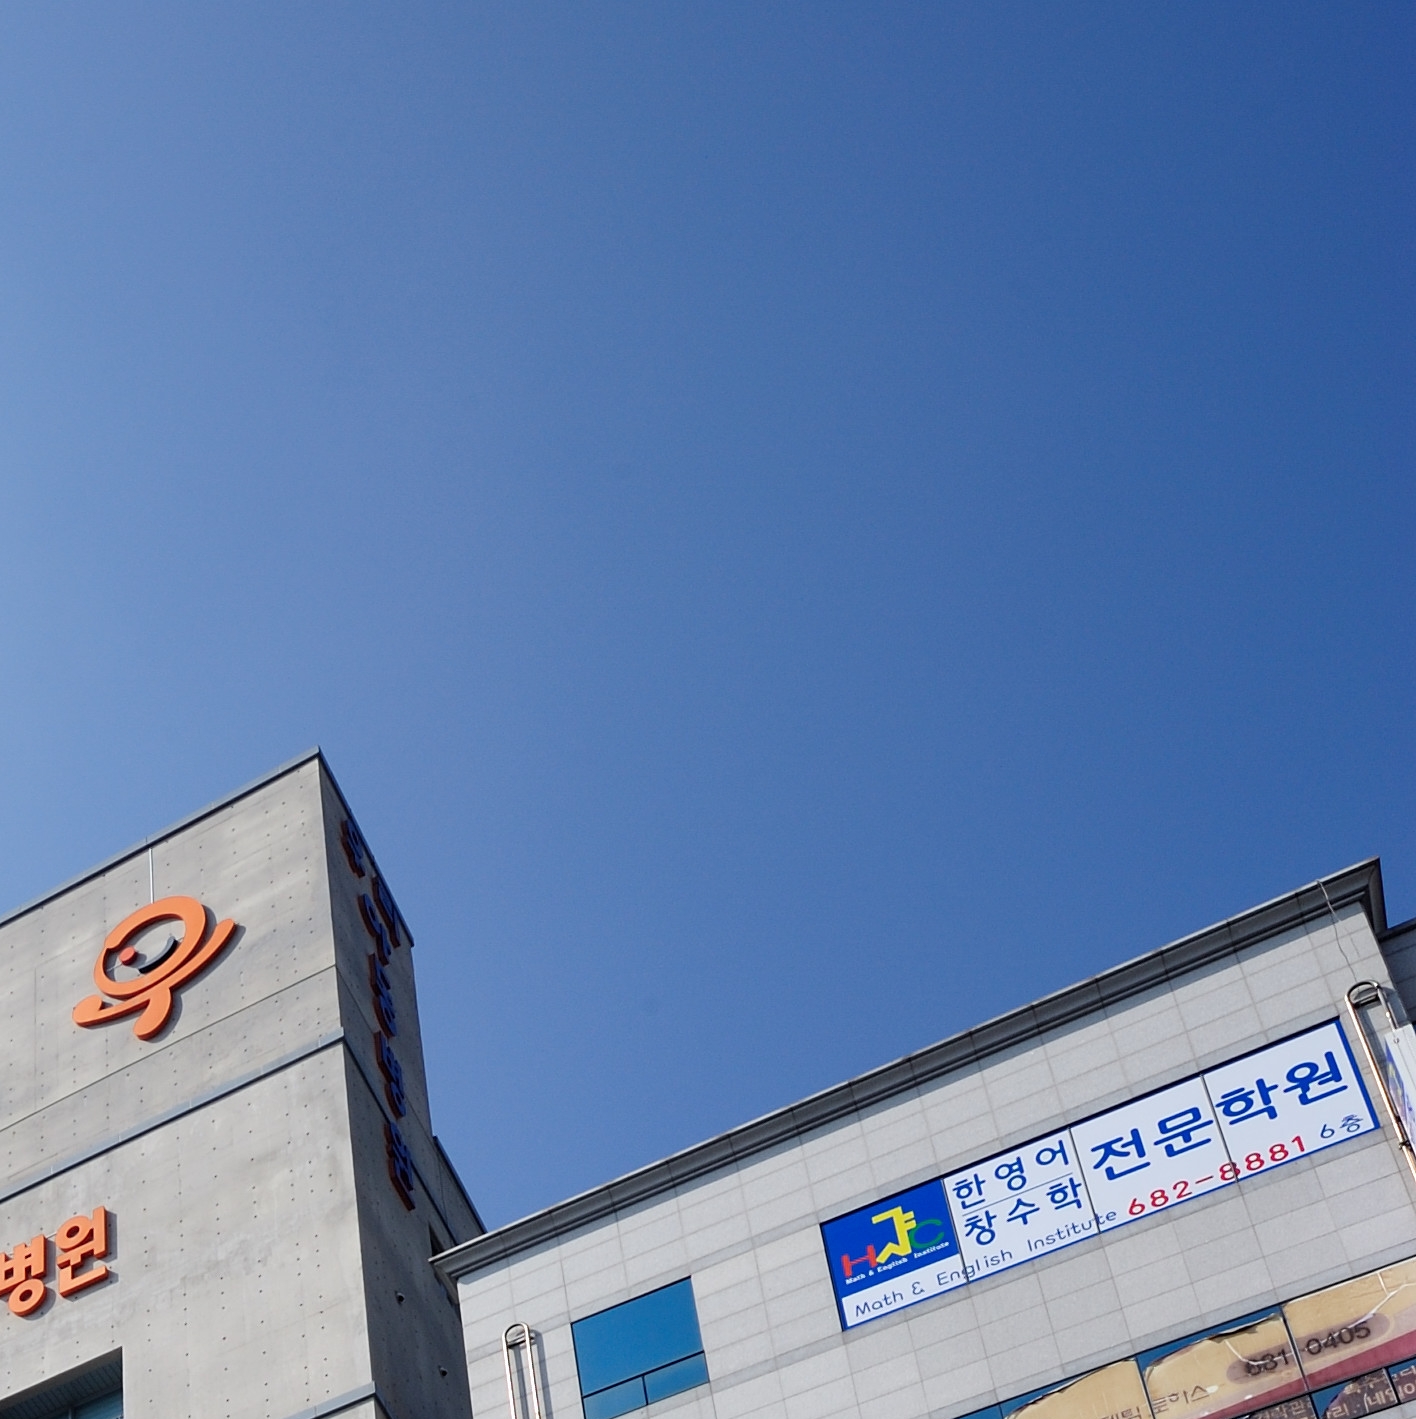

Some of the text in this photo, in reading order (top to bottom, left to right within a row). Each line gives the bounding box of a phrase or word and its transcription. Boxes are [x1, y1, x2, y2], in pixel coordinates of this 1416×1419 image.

[1092, 1051, 1348, 1182] 전문학원
[1320, 1113, 1364, 1139] 6층
[953, 1138, 1070, 1210] 한영어
[964, 1177, 1082, 1245] 창수학
[1127, 1135, 1306, 1217] 682-8881
[855, 1209, 1117, 1317] Math & English Institute
